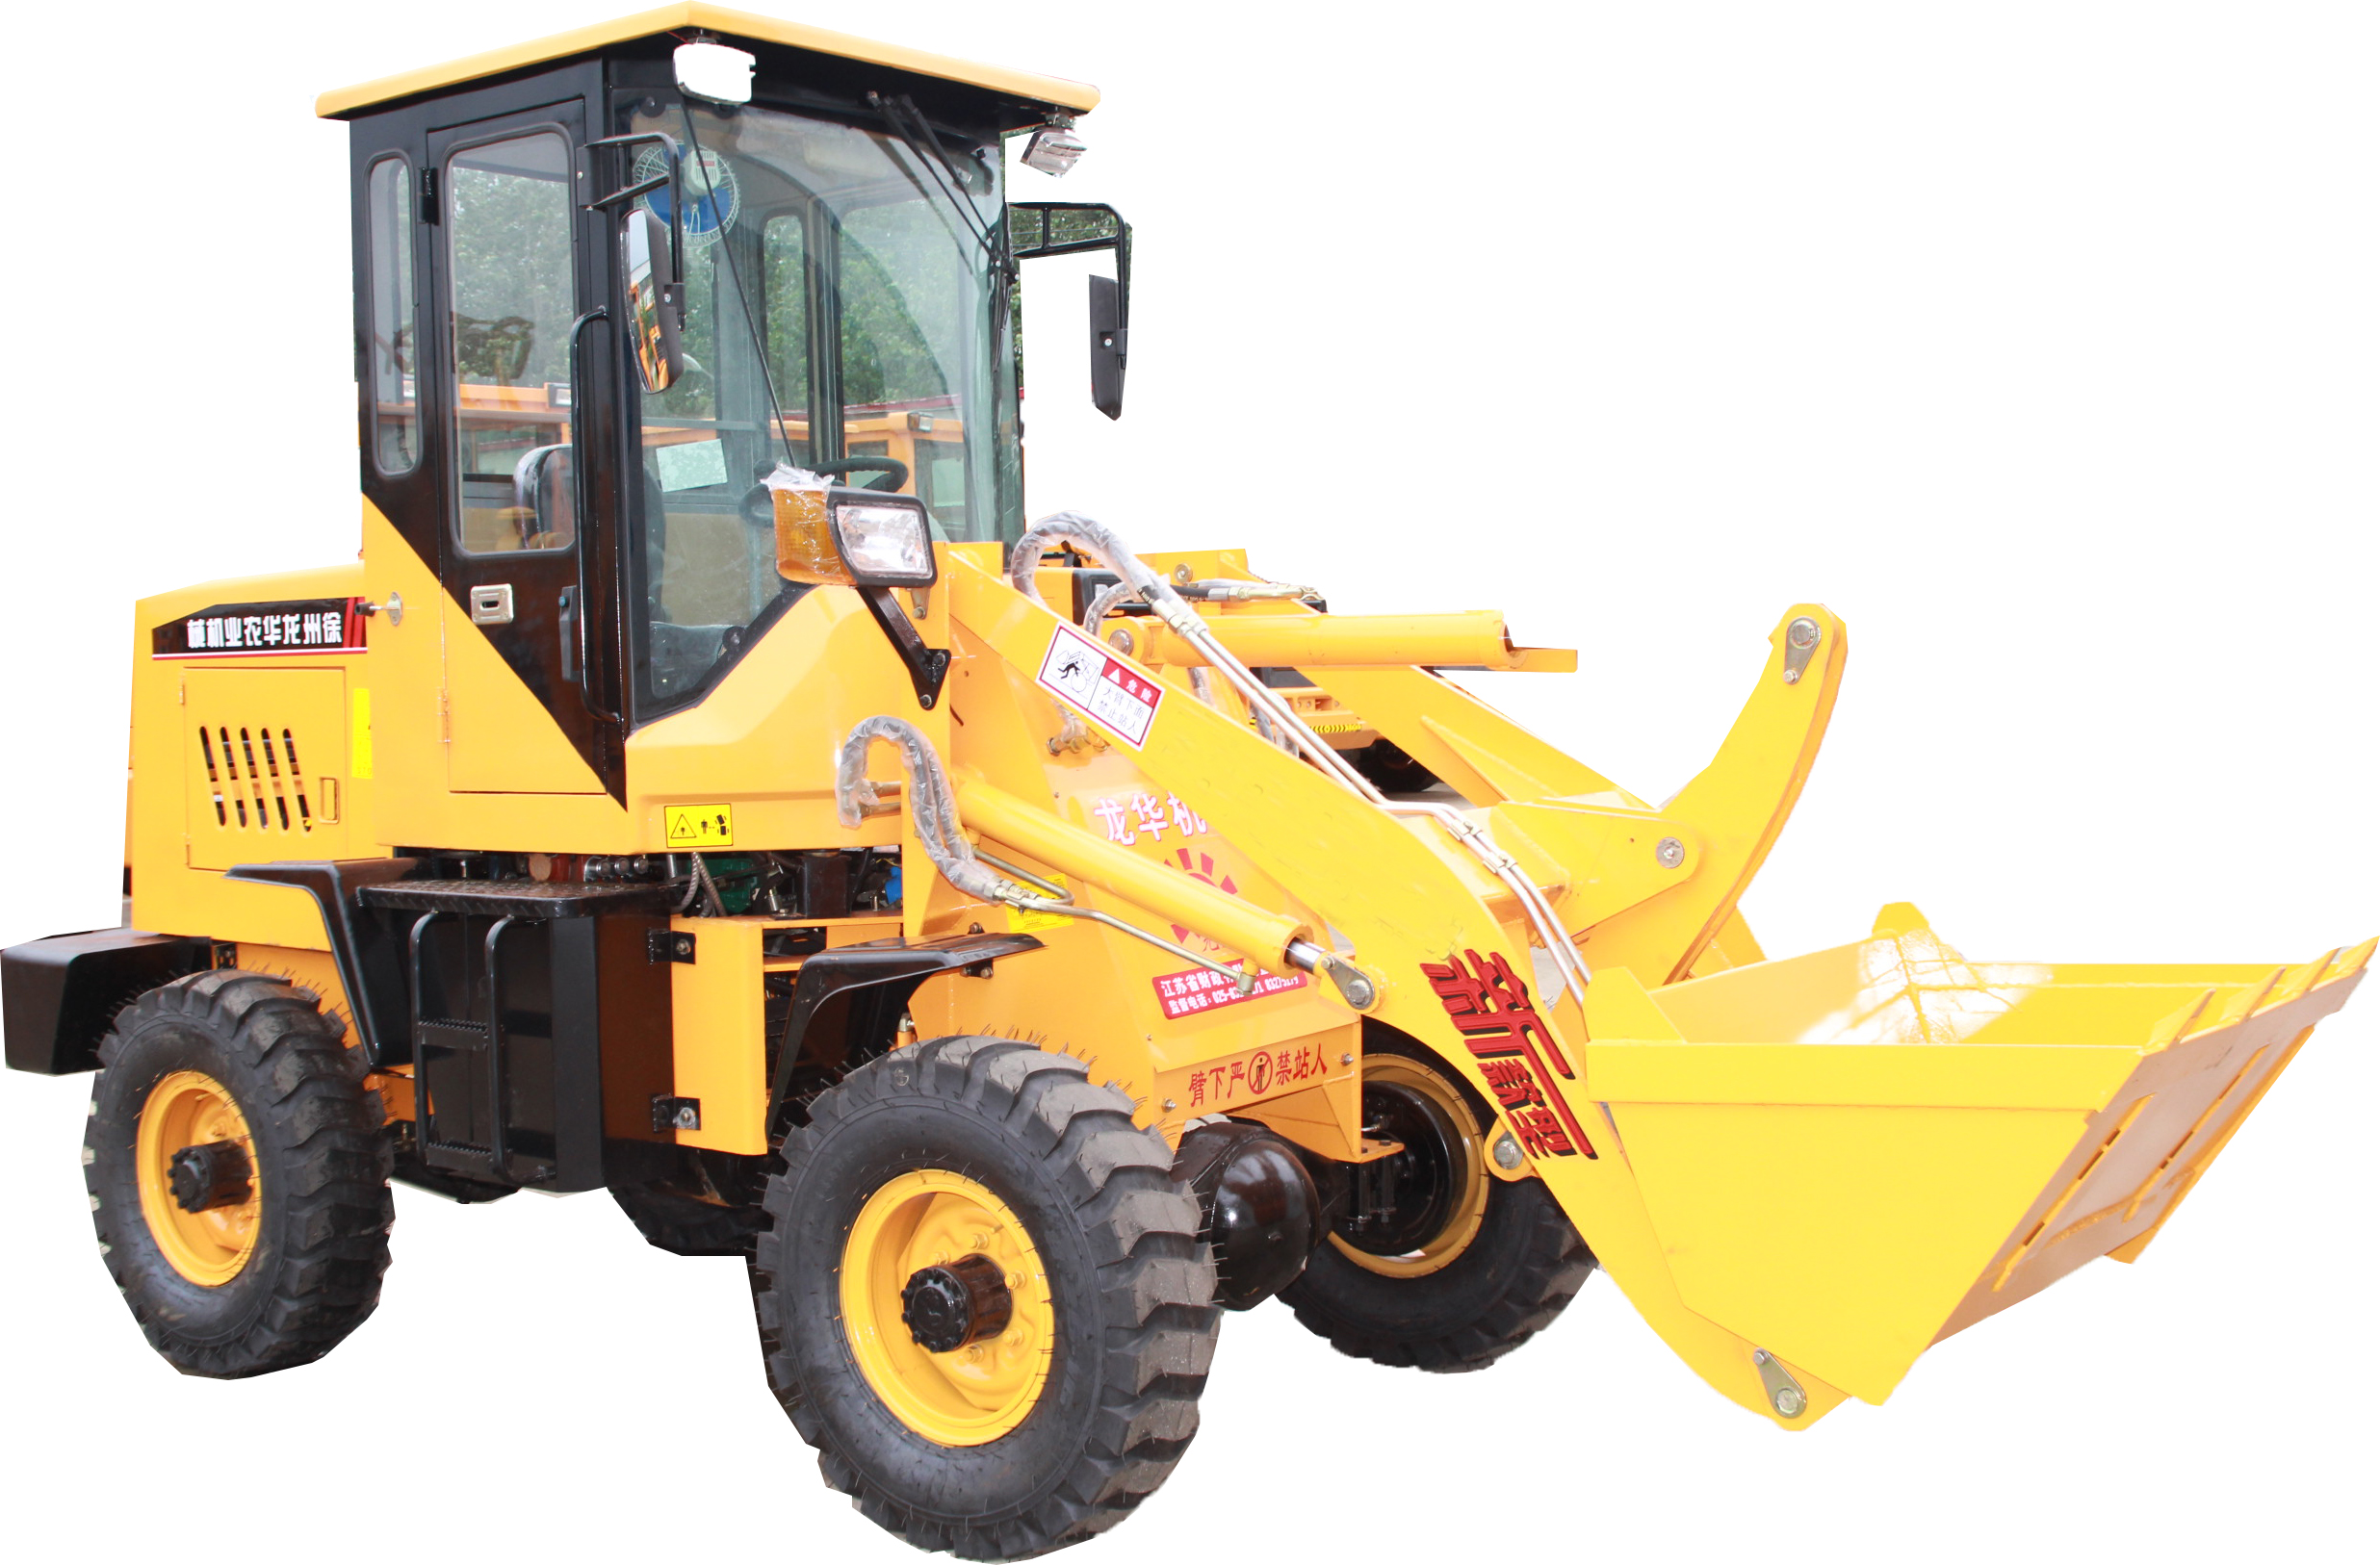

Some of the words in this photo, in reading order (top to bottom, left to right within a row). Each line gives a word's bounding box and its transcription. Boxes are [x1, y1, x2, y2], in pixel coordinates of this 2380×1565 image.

[1125, 679, 1152, 704] 危险
[1097, 700, 1138, 734] 禁止站人
